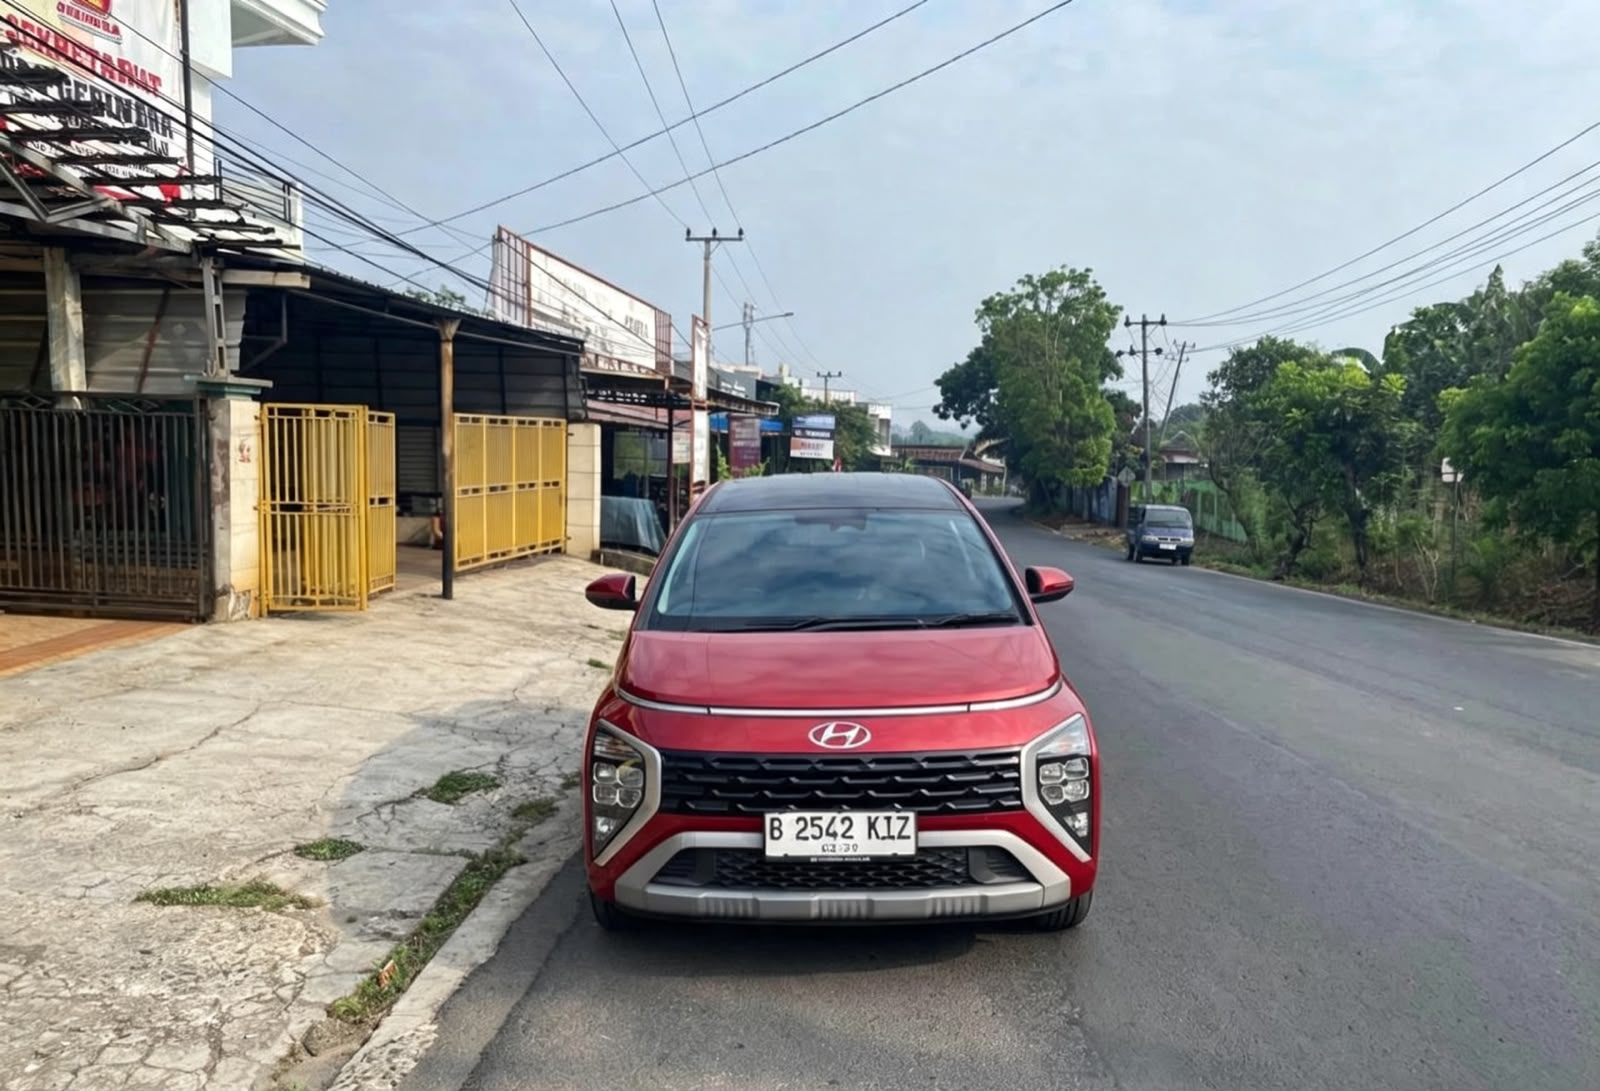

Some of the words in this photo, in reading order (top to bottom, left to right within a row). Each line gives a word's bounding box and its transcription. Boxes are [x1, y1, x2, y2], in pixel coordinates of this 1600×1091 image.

[5, 13, 162, 97] SEKRETARIAT
[769, 816, 783, 841] B
[795, 815, 854, 841] 2542
[866, 815, 911, 841] KIZ
